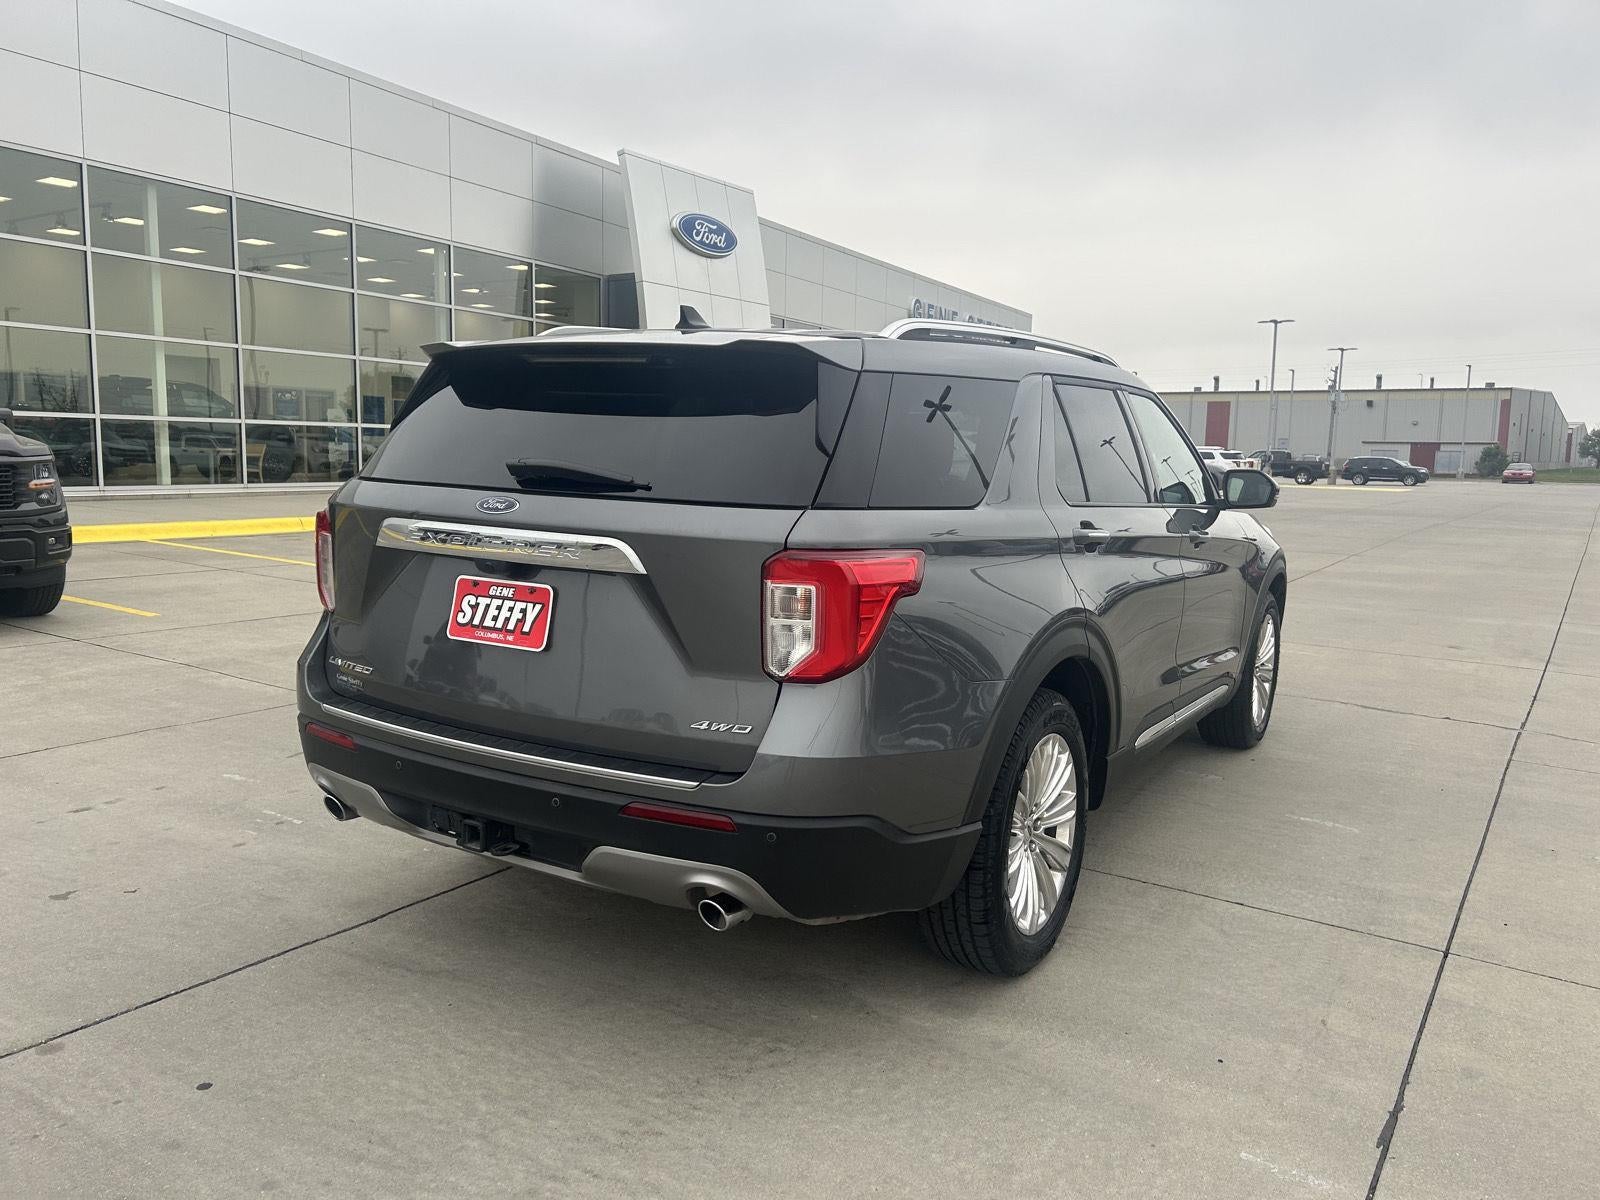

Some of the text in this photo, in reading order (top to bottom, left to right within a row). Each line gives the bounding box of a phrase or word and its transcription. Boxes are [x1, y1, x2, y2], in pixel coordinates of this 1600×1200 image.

[693, 220, 727, 247] Ford
[483, 498, 508, 510] Ford
[488, 585, 516, 598] GENE
[456, 594, 544, 635] STEFFY
[474, 630, 505, 641] COLUMBUS,
[328, 656, 373, 675] LIMITED
[690, 720, 753, 734] 4WD
